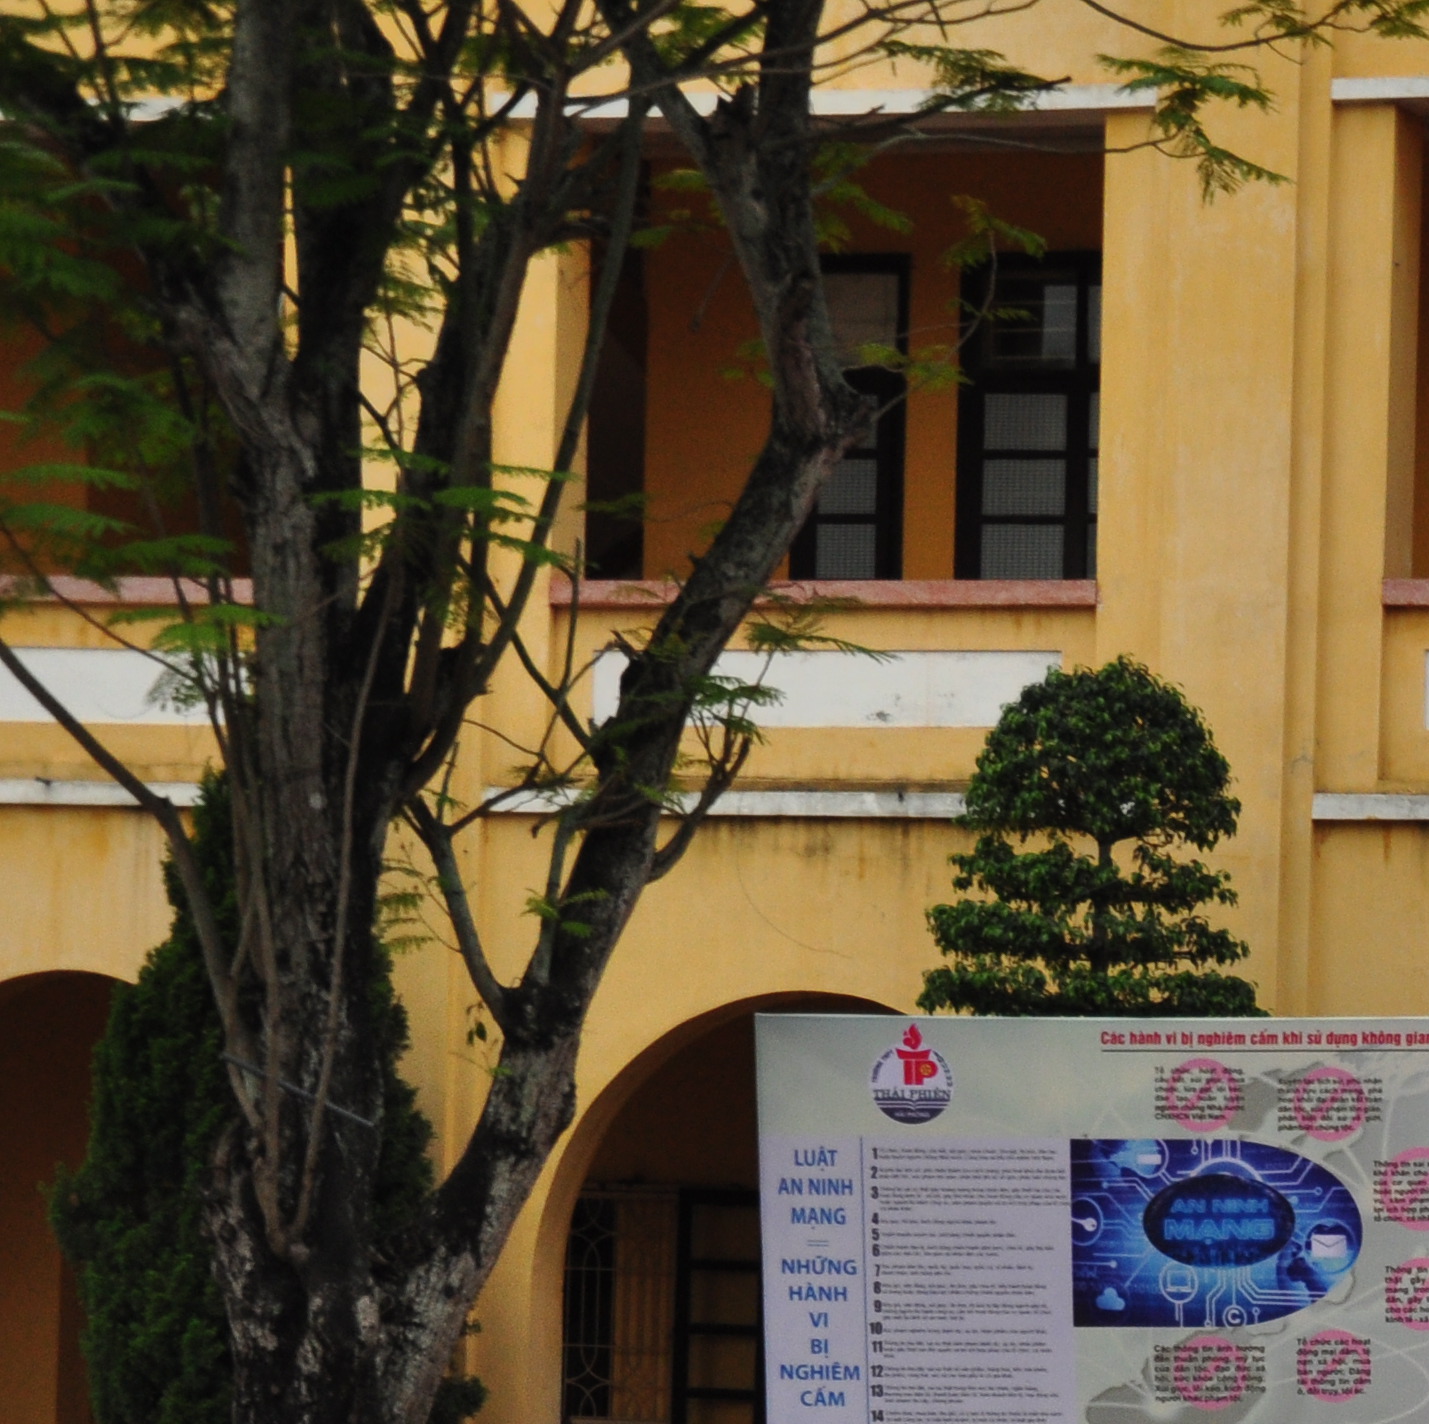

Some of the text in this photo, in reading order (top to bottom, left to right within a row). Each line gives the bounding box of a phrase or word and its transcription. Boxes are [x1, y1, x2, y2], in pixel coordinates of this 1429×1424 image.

[1100, 1031, 1125, 1045] Các
[1129, 1031, 1162, 1045] hành
[1165, 1032, 1177, 1045] vi
[1181, 1031, 1193, 1048] bị
[1197, 1031, 1246, 1047] nghiêm
[1250, 1028, 1279, 1045] cấm
[1282, 1030, 1303, 1045] khi
[1306, 1029, 1323, 1045] sử
[1326, 1031, 1358, 1048] dụng
[1361, 1030, 1402, 1047] không
[794, 1146, 838, 1172] LUẬT
[872, 1148, 878, 1160] 1
[871, 1166, 878, 1179] 2
[778, 1177, 854, 1196] AN NINH
[871, 1186, 879, 1199] 3
[1170, 1199, 1268, 1213] AN NINH
[791, 1206, 847, 1230] MẠNG
[871, 1212, 879, 1225] 4
[871, 1228, 880, 1241] 5
[1163, 1219, 1275, 1244] MẠNG
[872, 1244, 880, 1257] 6
[781, 1255, 858, 1276] NHỮNG
[874, 1264, 881, 1277] 7
[788, 1283, 848, 1301] HÀNH
[874, 1281, 882, 1295] 8
[874, 1300, 882, 1313] 9
[809, 1312, 829, 1328] VI
[869, 1322, 883, 1335] 10
[810, 1339, 829, 1358] BỊ
[871, 1341, 883, 1353] 11
[779, 1362, 861, 1381] NGHIÊM
[870, 1365, 884, 1378] 12
[799, 1386, 846, 1407] CẤM
[870, 1385, 884, 1398] 13
[871, 1410, 884, 1422] 14
